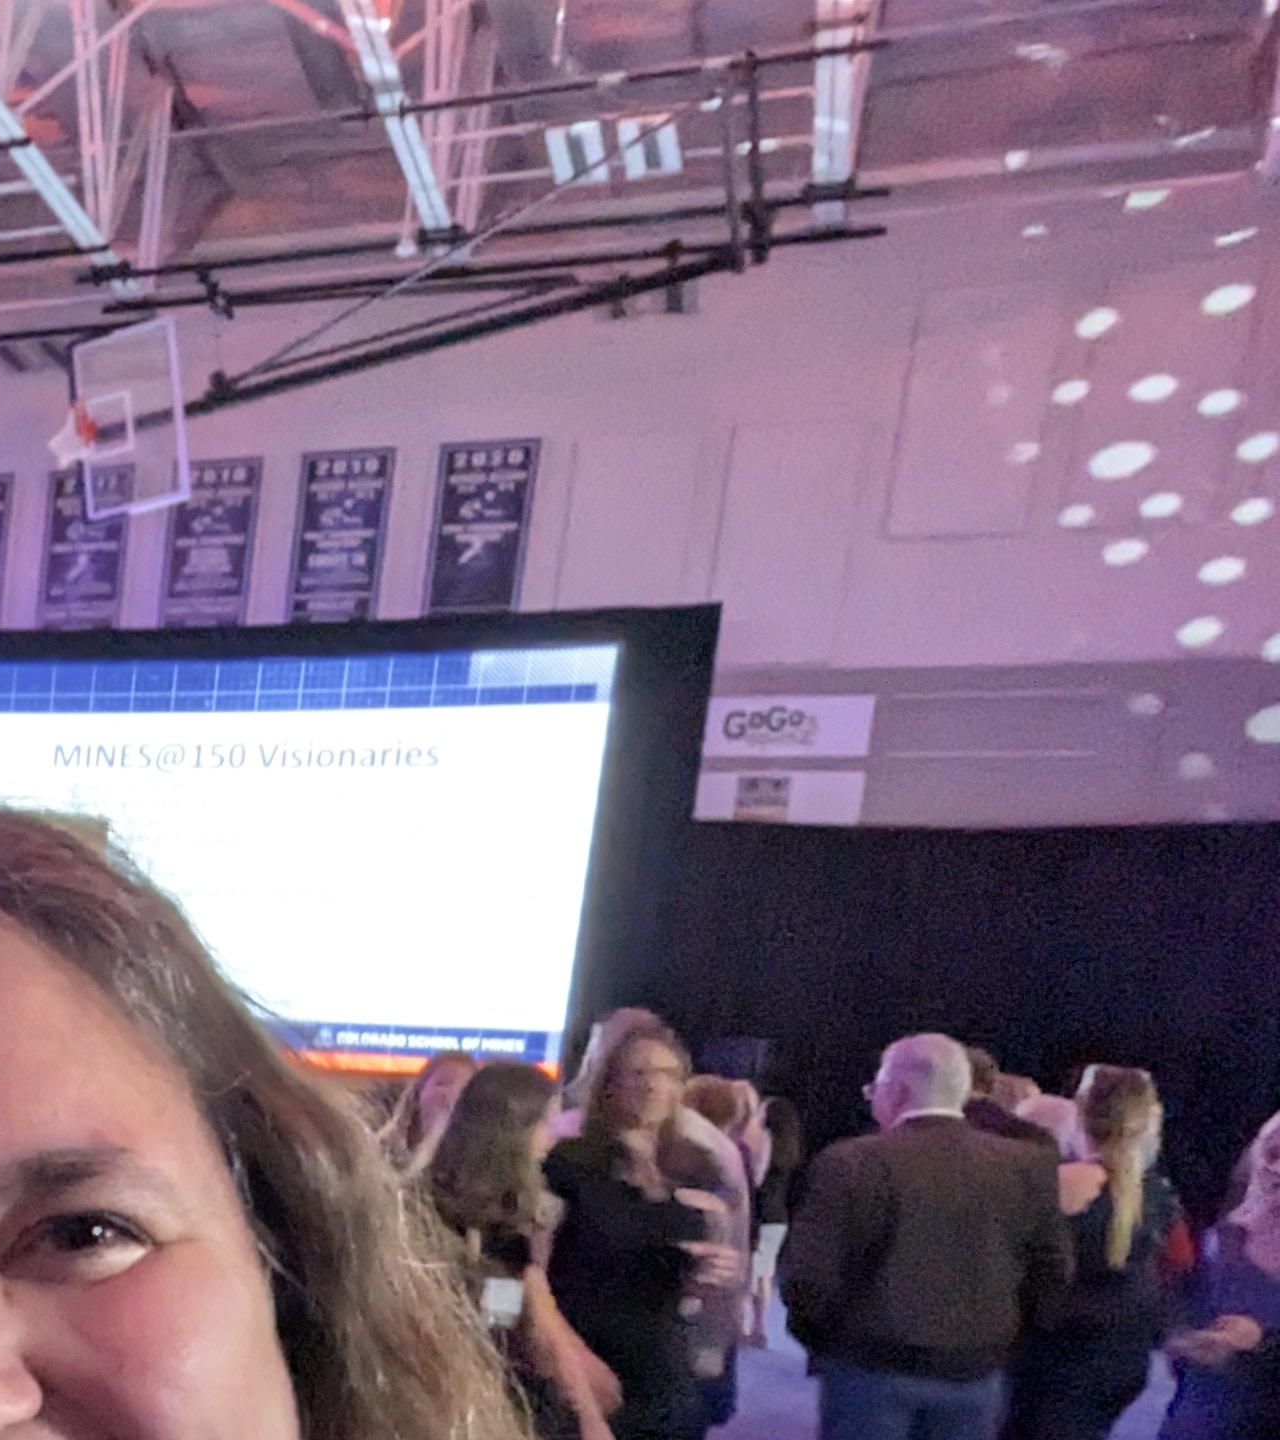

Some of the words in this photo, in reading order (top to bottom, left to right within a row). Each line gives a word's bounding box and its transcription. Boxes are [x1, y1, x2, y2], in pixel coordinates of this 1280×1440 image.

[723, 705, 805, 739] GoGo
[53, 743, 247, 773] MINES@150
[259, 740, 440, 769] Visionaries
[337, 1031, 406, 1049] COLORADO
[407, 1034, 460, 1050] SCHOOL
[461, 1037, 480, 1051] OF
[481, 1038, 526, 1053] MINES
